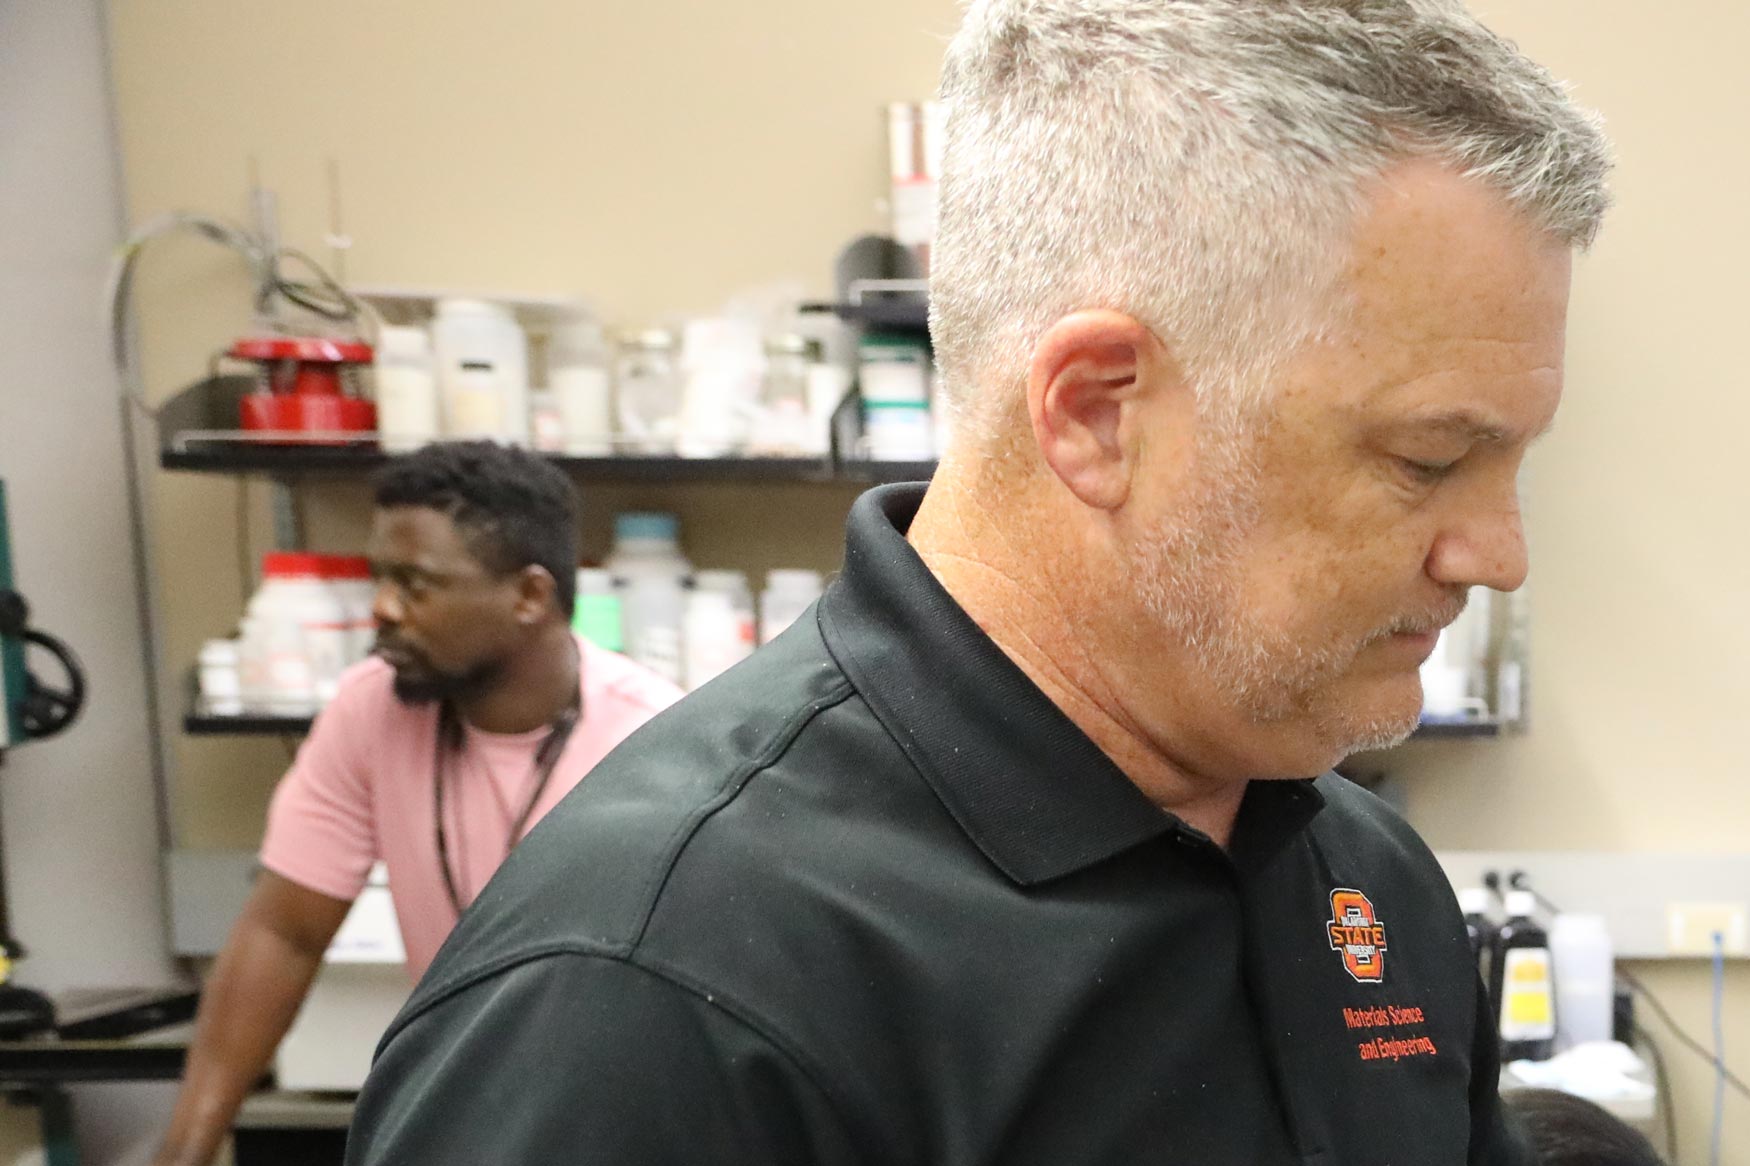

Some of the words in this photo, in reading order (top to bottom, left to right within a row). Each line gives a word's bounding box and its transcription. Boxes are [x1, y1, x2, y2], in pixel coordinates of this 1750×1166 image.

[1330, 925, 1386, 946] STATE
[1343, 1005, 1390, 1029] Materials
[1387, 1004, 1424, 1026] Science
[1359, 1038, 1381, 1060] and
[1376, 1033, 1437, 1062] Engineering
